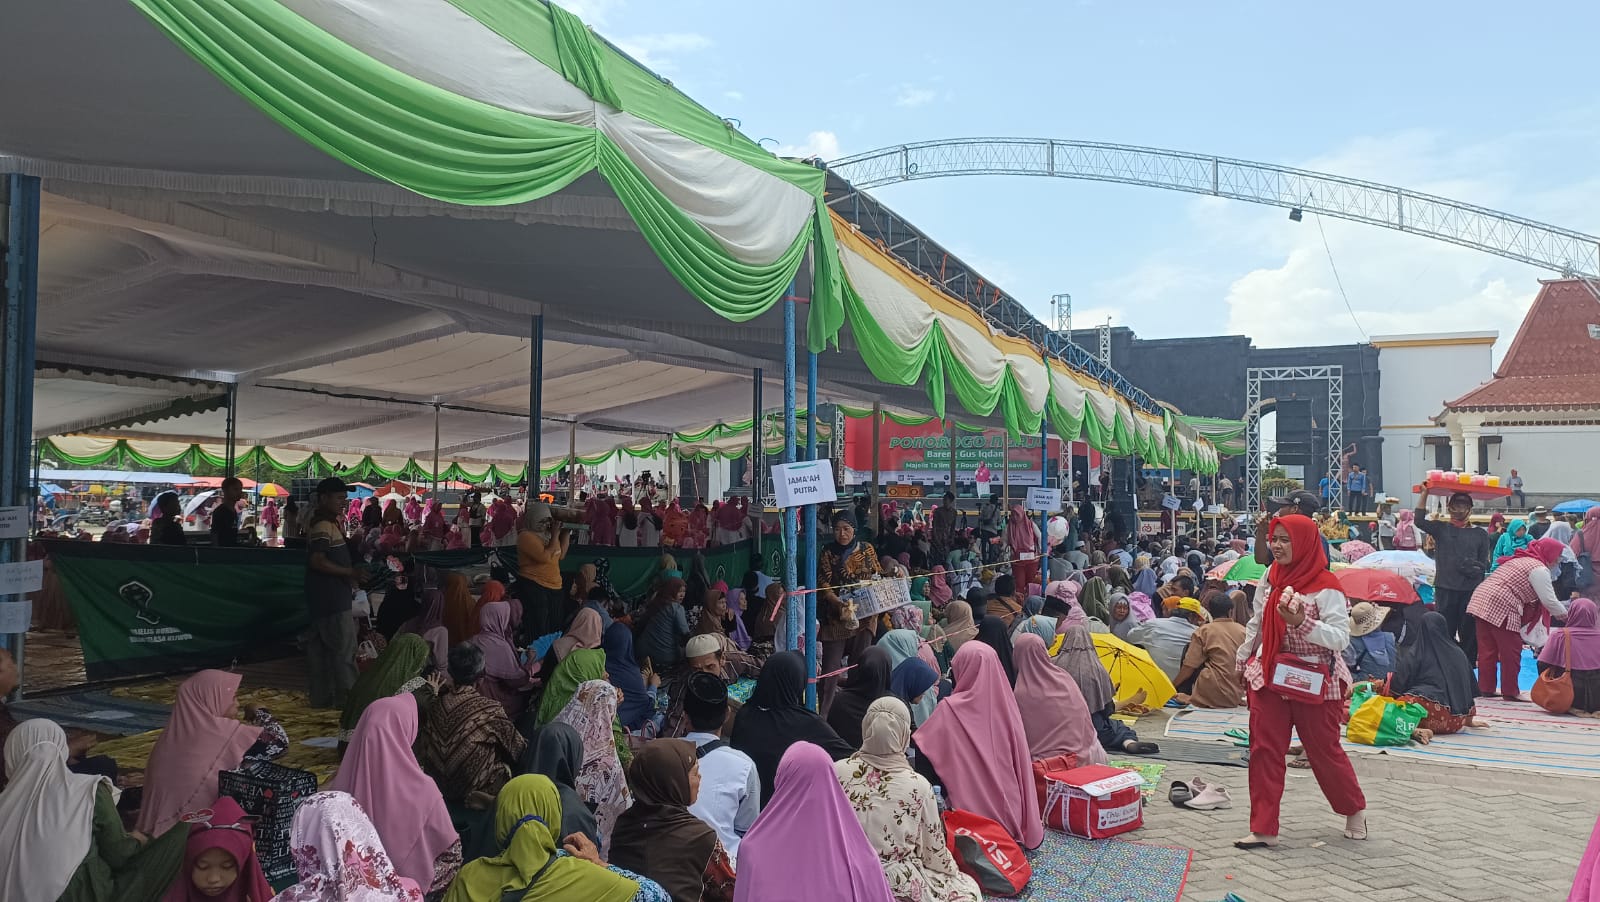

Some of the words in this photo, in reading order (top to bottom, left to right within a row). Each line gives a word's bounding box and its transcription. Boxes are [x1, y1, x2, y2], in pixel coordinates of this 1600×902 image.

[927, 450, 958, 459] Baren
[960, 450, 976, 458] Gus
[788, 474, 821, 485] JAMA'AH
[794, 486, 818, 495] PUTRA
